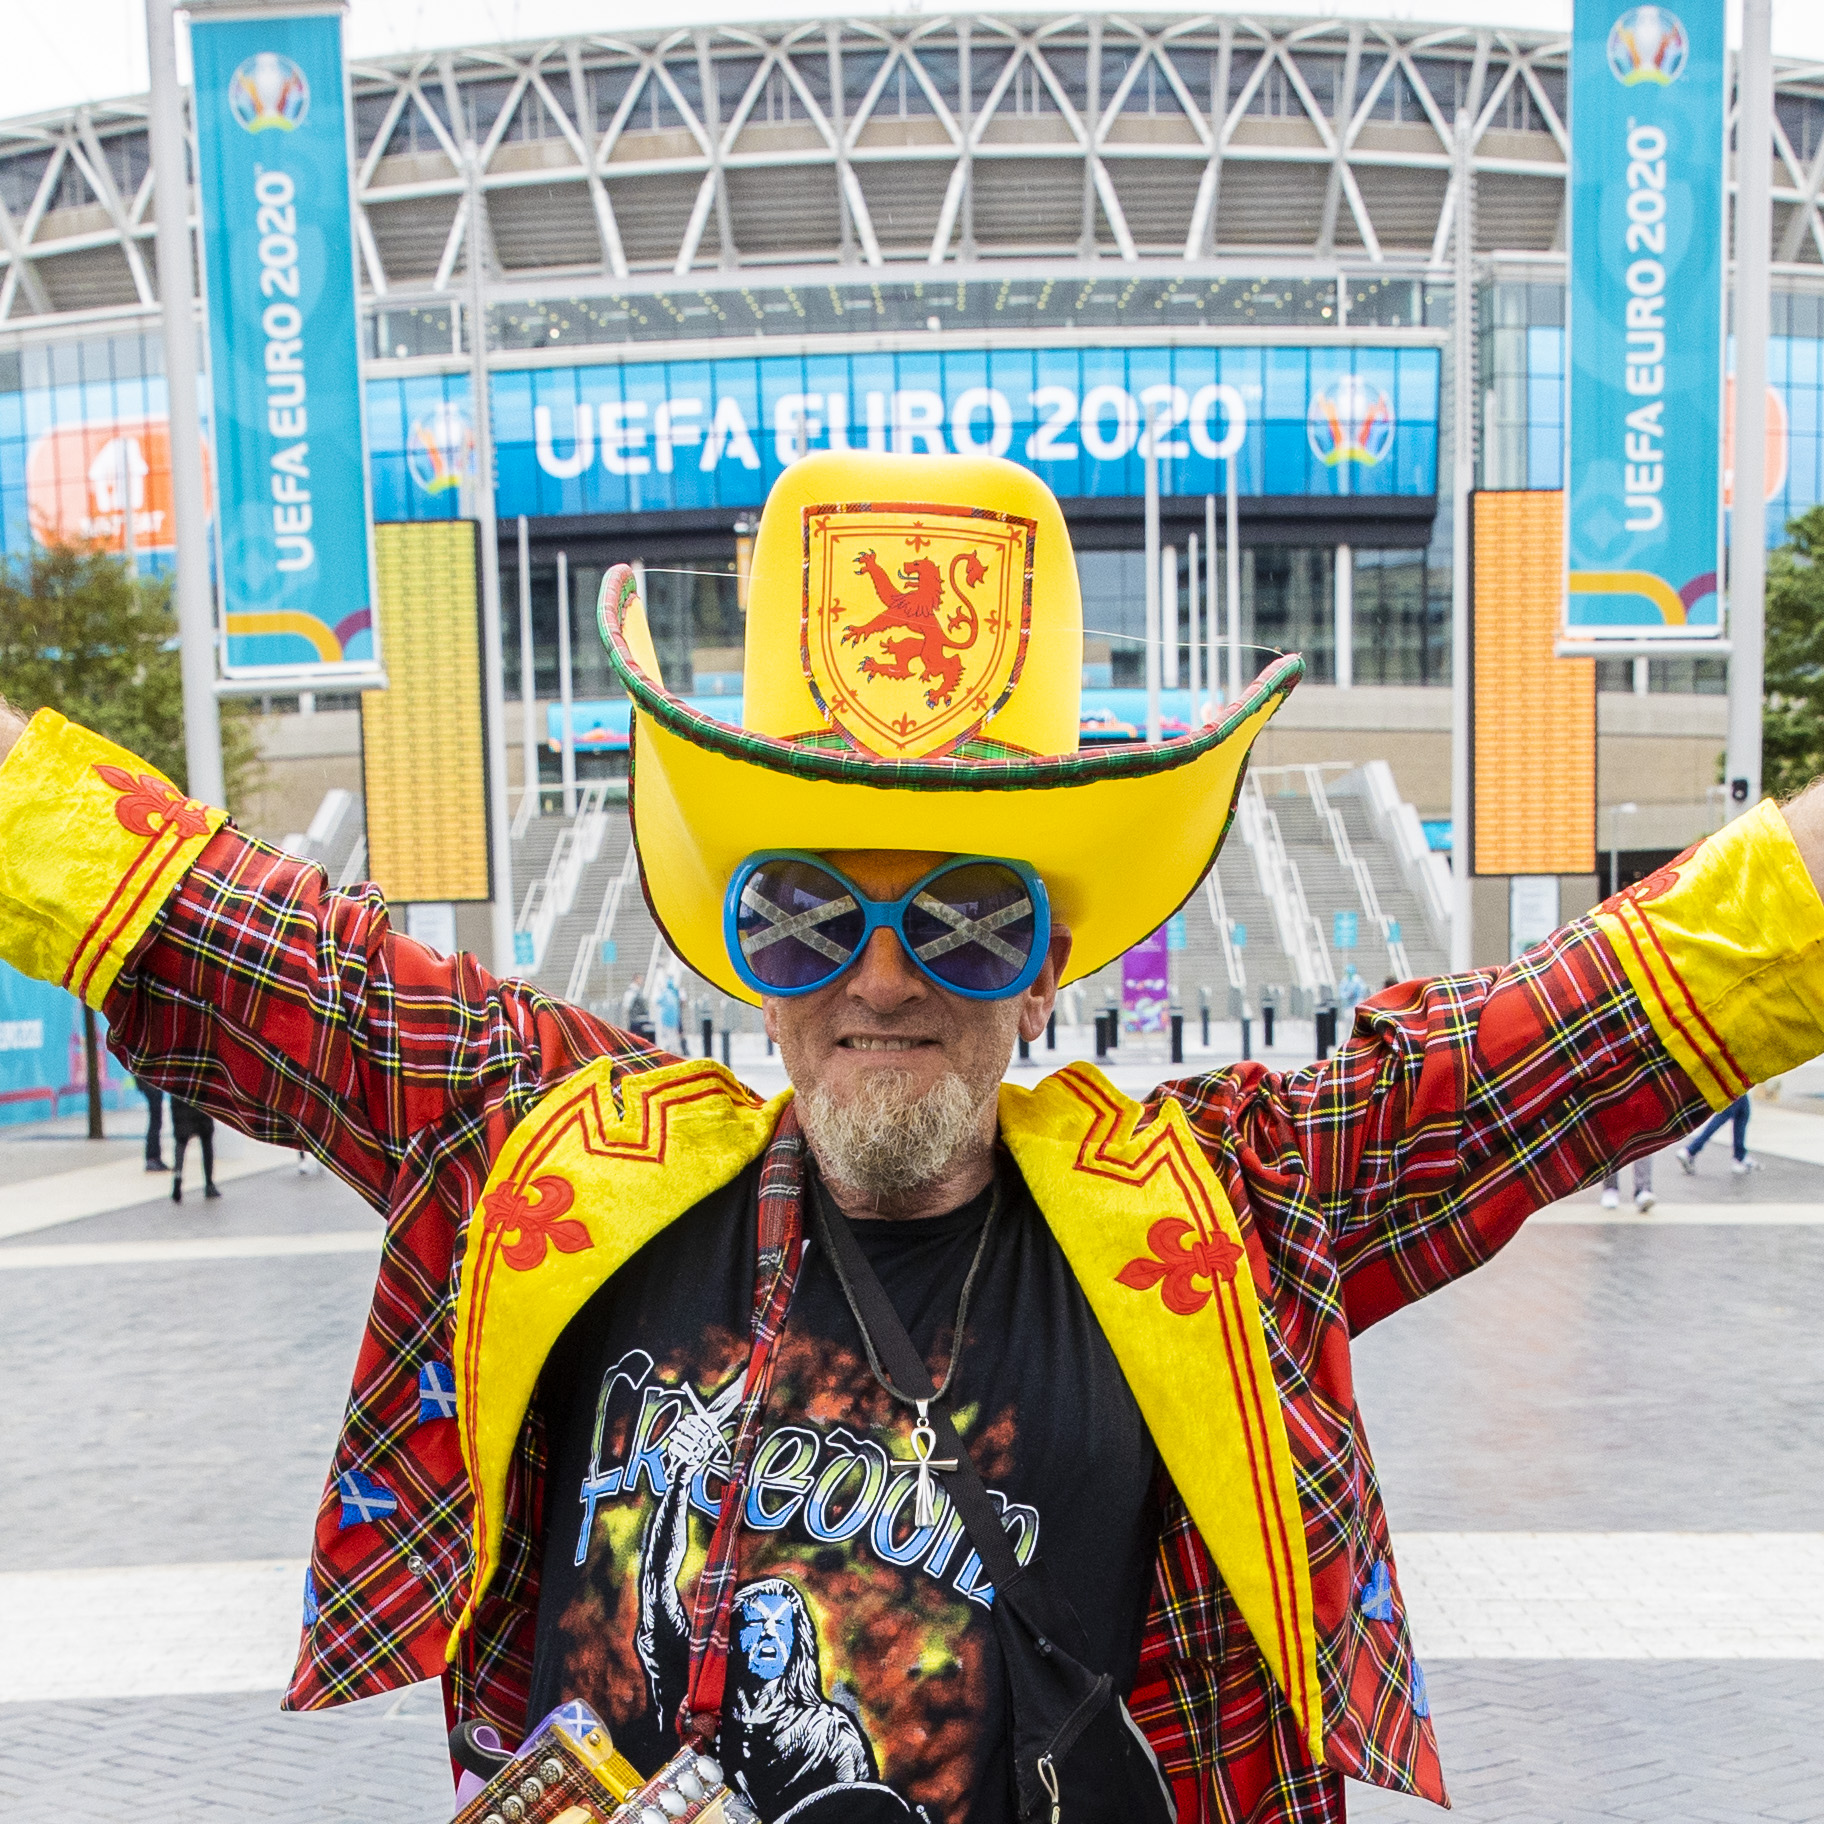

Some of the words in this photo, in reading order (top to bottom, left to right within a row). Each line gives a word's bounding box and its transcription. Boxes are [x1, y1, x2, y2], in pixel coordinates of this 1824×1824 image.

[261, 301, 308, 437] EURO
[1625, 258, 1667, 396] EURO
[534, 396, 761, 480] UEFA
[774, 386, 1014, 467] EURO
[1624, 400, 1665, 532] UEFA
[269, 442, 315, 572] UEFA
